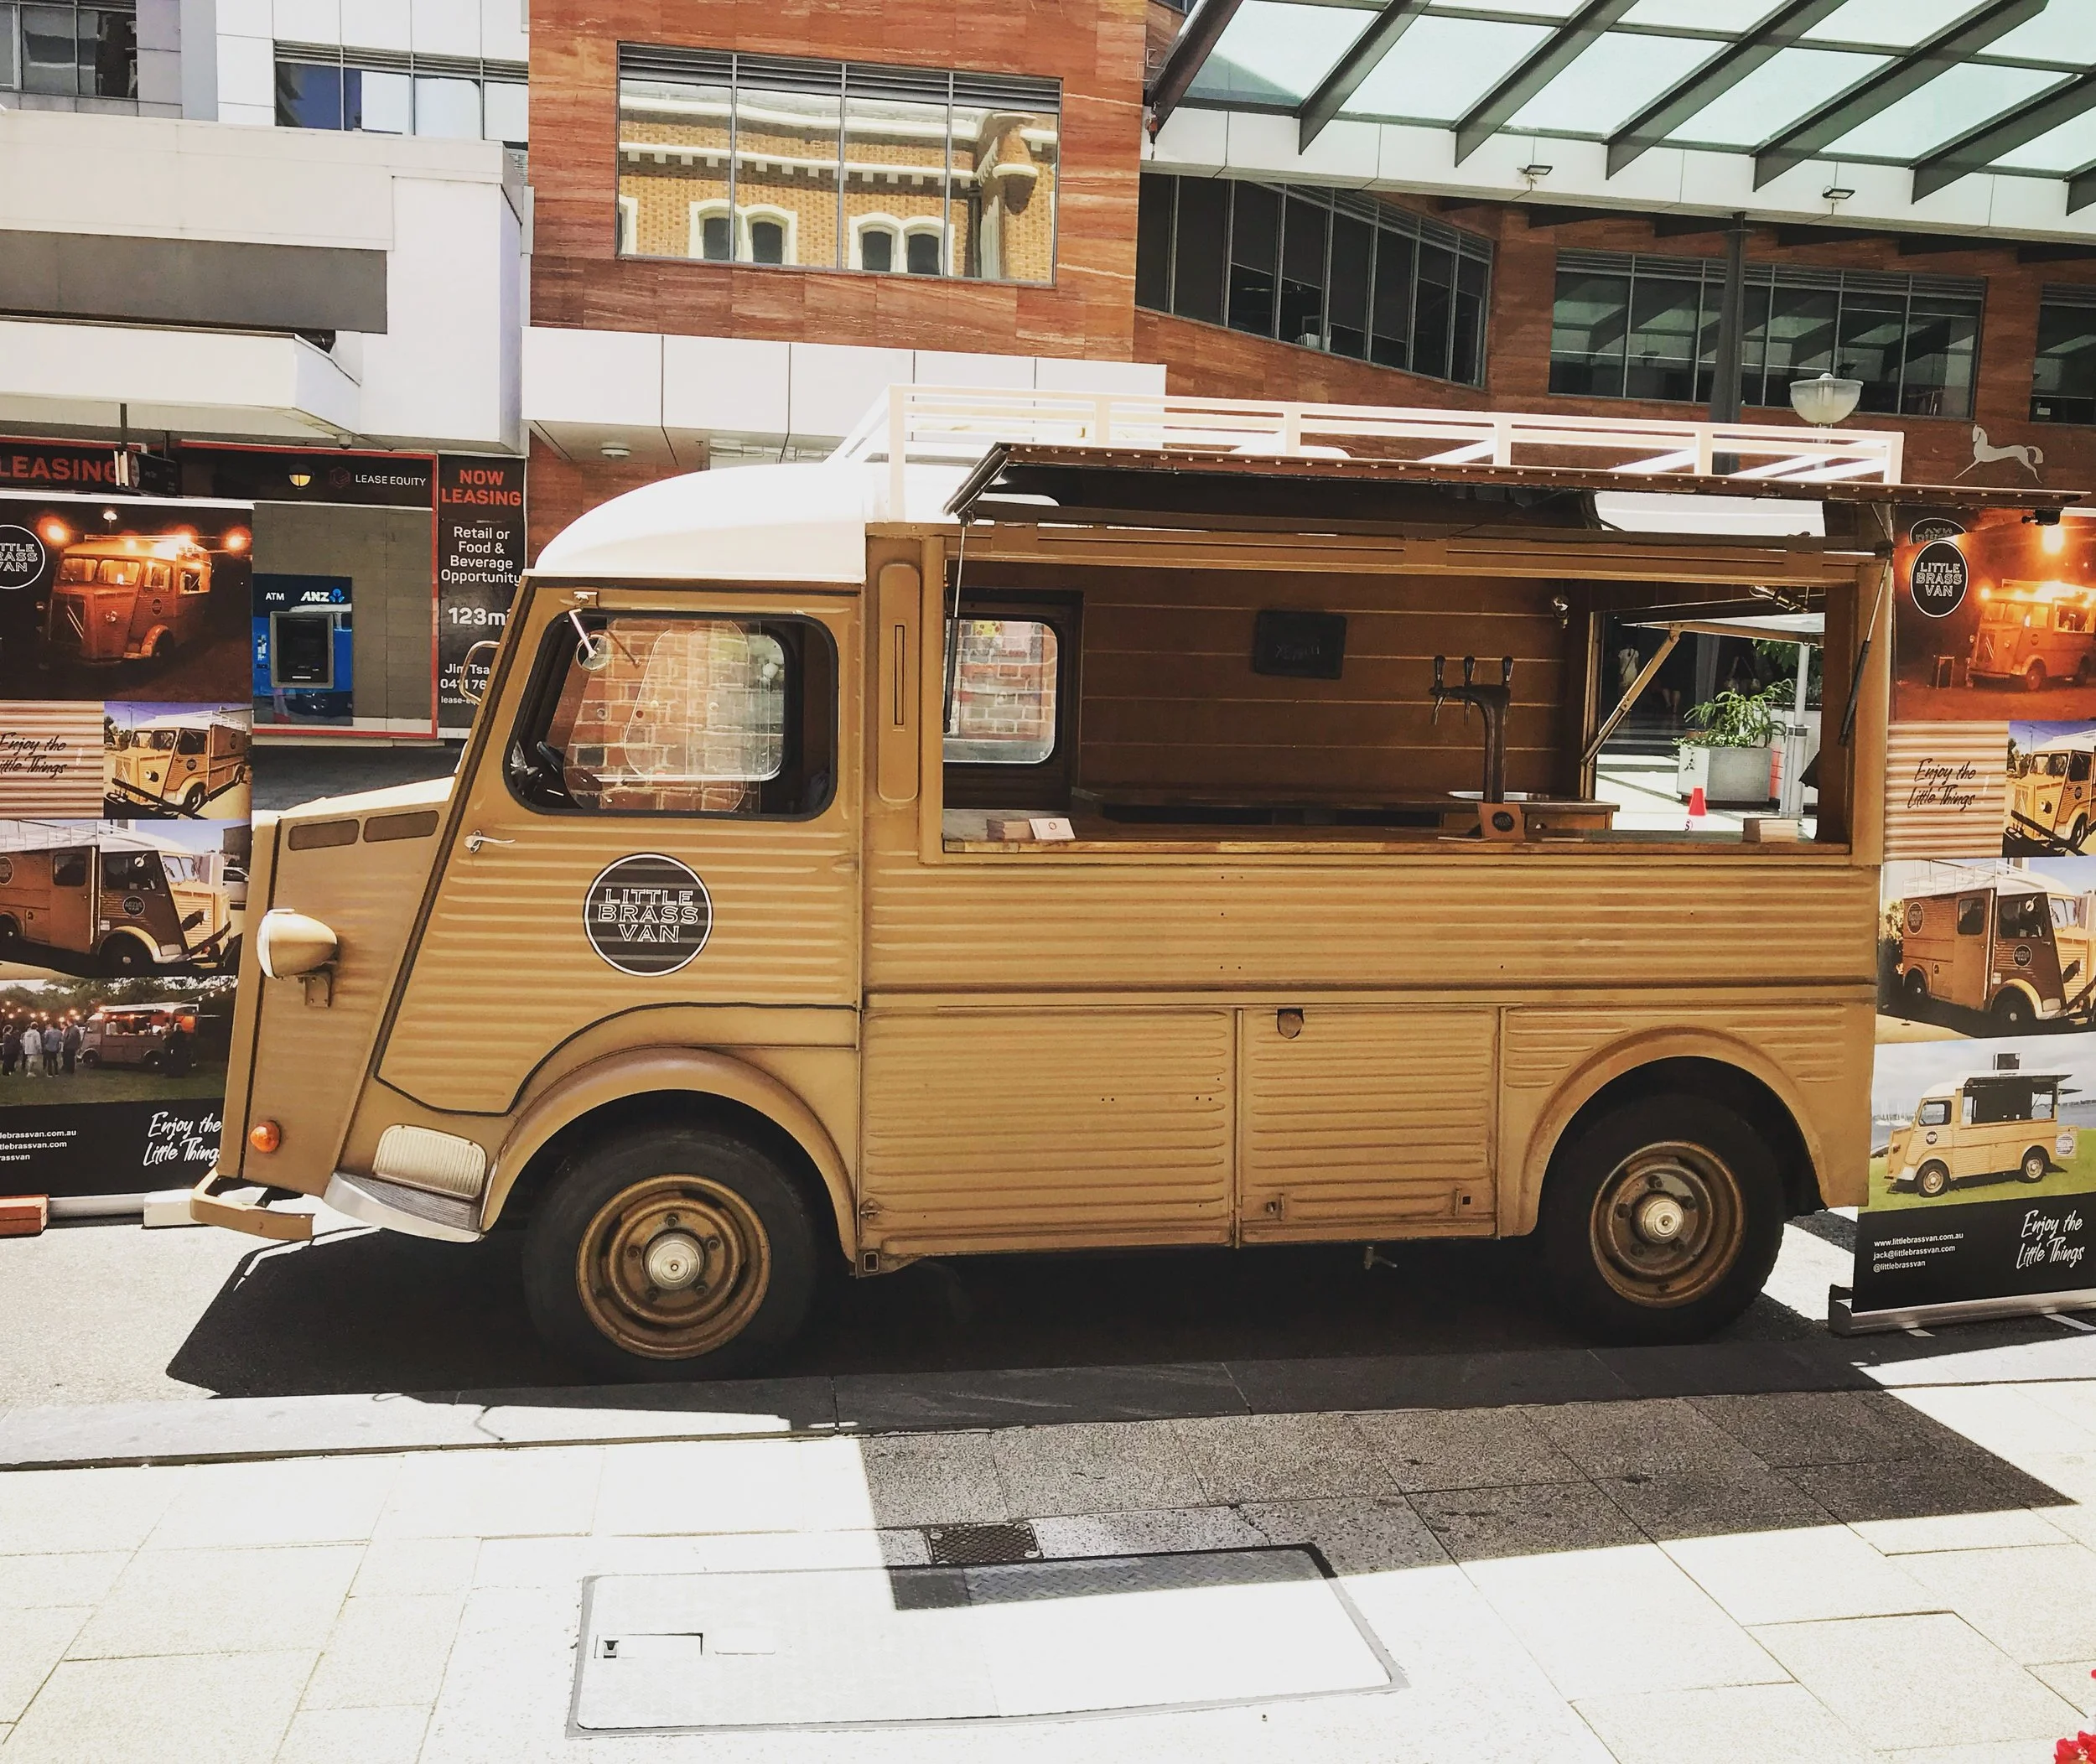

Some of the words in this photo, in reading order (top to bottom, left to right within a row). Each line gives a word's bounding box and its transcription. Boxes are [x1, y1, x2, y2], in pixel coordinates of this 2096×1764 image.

[355, 474, 387, 485] LEASE
[390, 475, 427, 486] EQUITY
[459, 470, 505, 485] NOW
[441, 487, 521, 506] LEASING
[454, 526, 492, 539] Retail
[496, 530, 511, 540] or
[458, 541, 491, 553] Food
[495, 542, 506, 554] &
[450, 554, 514, 571] Beverage
[1920, 562, 1960, 573] LITTLE
[441, 569, 521, 587] Opportunity
[1916, 572, 1963, 585] BRASS
[265, 592, 285, 601] ATM
[300, 590, 330, 603] ANZ
[1925, 584, 1953, 597] VAN
[0, 732, 40, 755] Enjoy
[44, 734, 67, 752] the
[24, 755, 68, 780] Things
[1914, 758, 1953, 786] Enjoy
[1956, 760, 1977, 781] the
[1907, 786, 1936, 809] Little
[1938, 784, 1976, 812] Things
[604, 888, 694, 906] LITTLE
[597, 904, 699, 925] BRASS
[618, 923, 680, 943] VAN
[148, 1111, 194, 1141] Enjoy
[198, 1113, 223, 1134] the
[143, 1141, 179, 1166] Little
[179, 1137, 220, 1167] Thing
[2021, 1209, 2060, 1241] Enjoy
[2062, 1209, 2083, 1232] the
[1874, 1232, 1964, 1247] www.littlebrassvan.com.au
[1872, 1245, 1956, 1261] jack@littlebrassvan.com
[2016, 1242, 2046, 1269] Little
[2046, 1236, 2086, 1269] Things
[1872, 1259, 1927, 1274] @littlebrassvan
